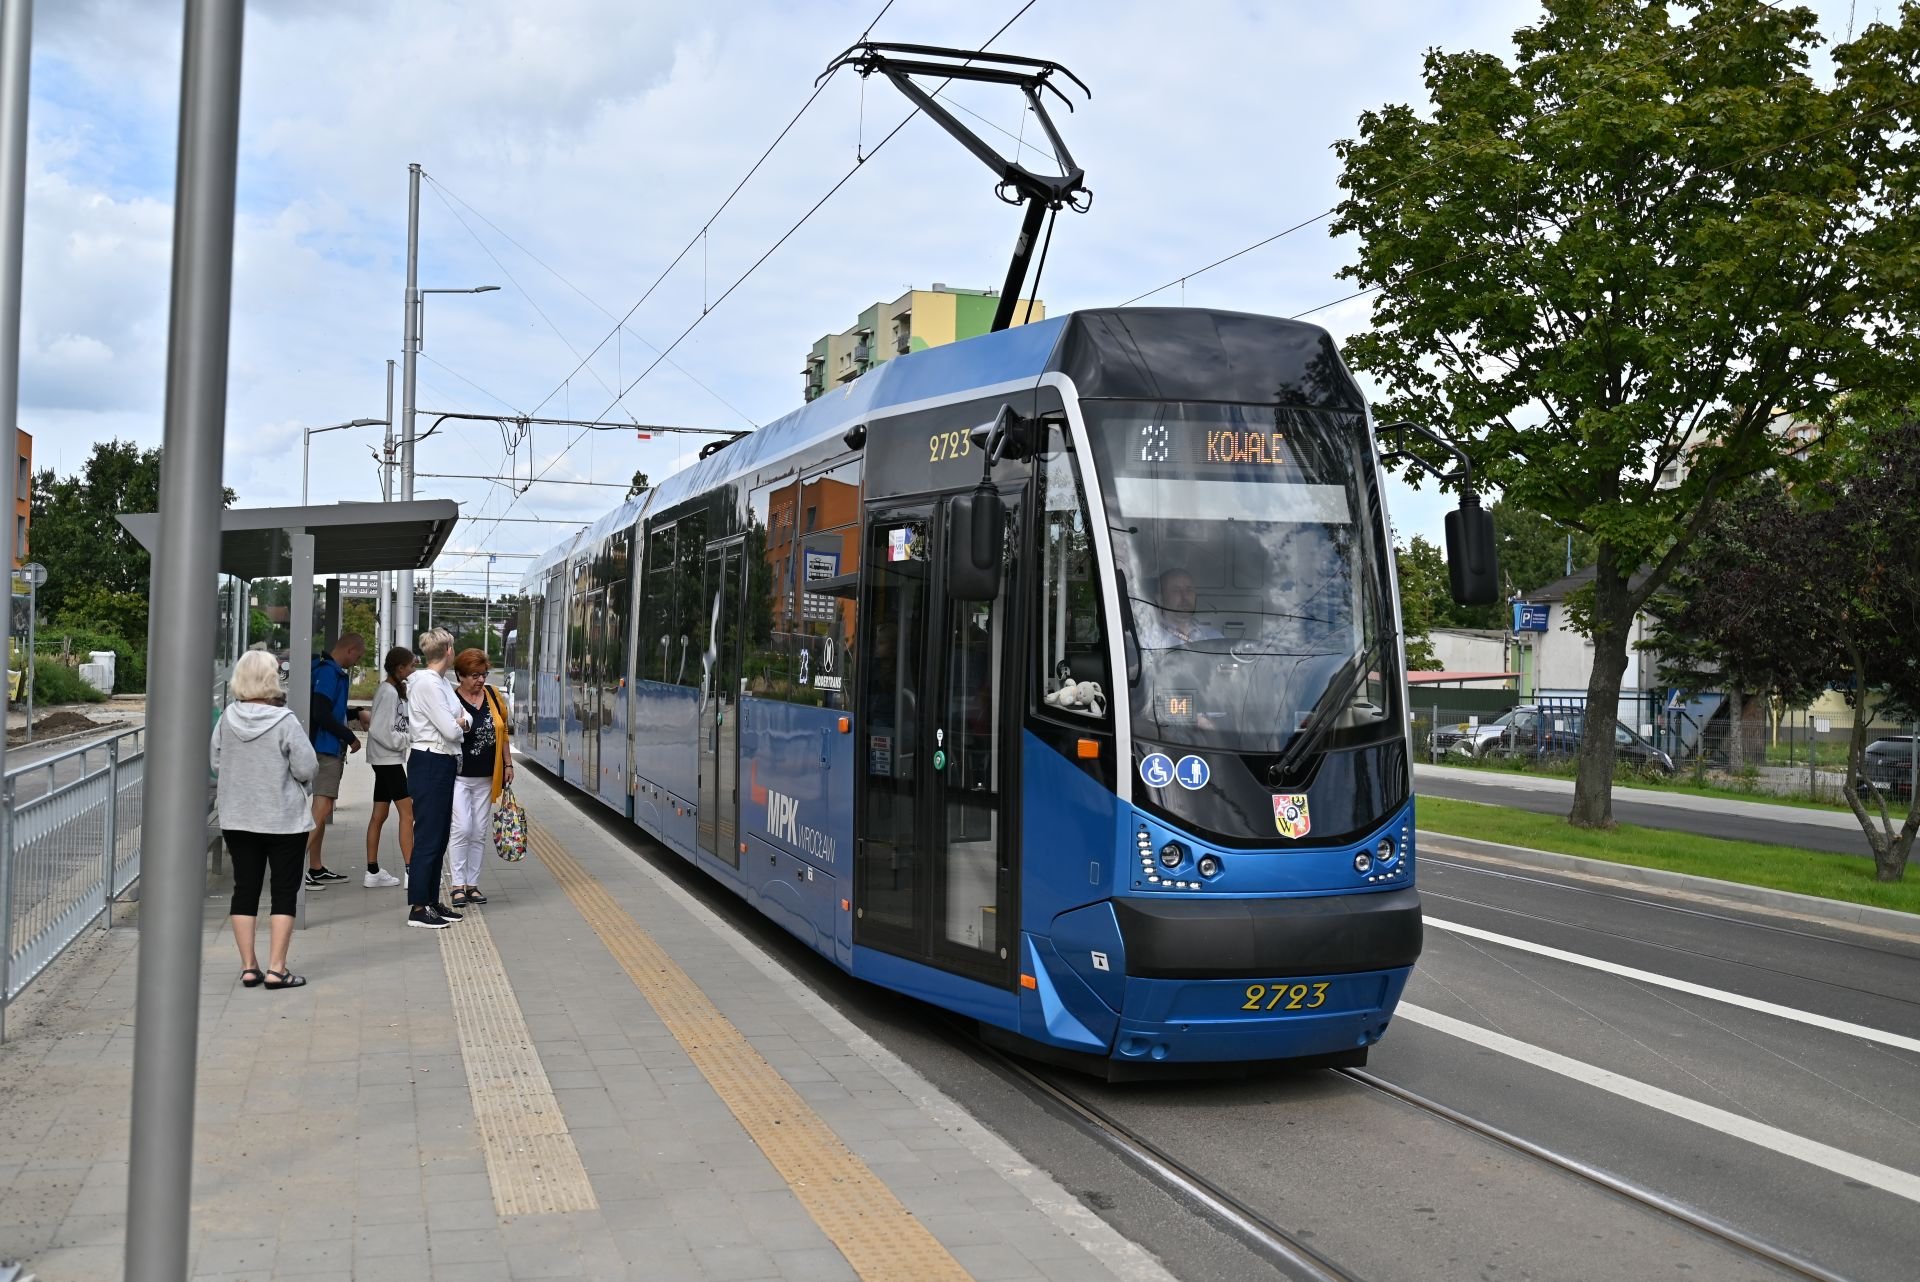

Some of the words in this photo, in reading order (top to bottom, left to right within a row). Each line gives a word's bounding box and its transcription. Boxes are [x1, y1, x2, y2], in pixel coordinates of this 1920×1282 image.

[929, 428, 971, 463] 2723
[1141, 425, 1168, 461] 23
[1207, 430, 1284, 464] KOWALE
[1522, 612, 1531, 624] P
[1170, 698, 1187, 715] 04
[767, 789, 799, 846] MPK
[798, 823, 836, 864] WROCŁAW
[1240, 981, 1332, 1011] 2723
